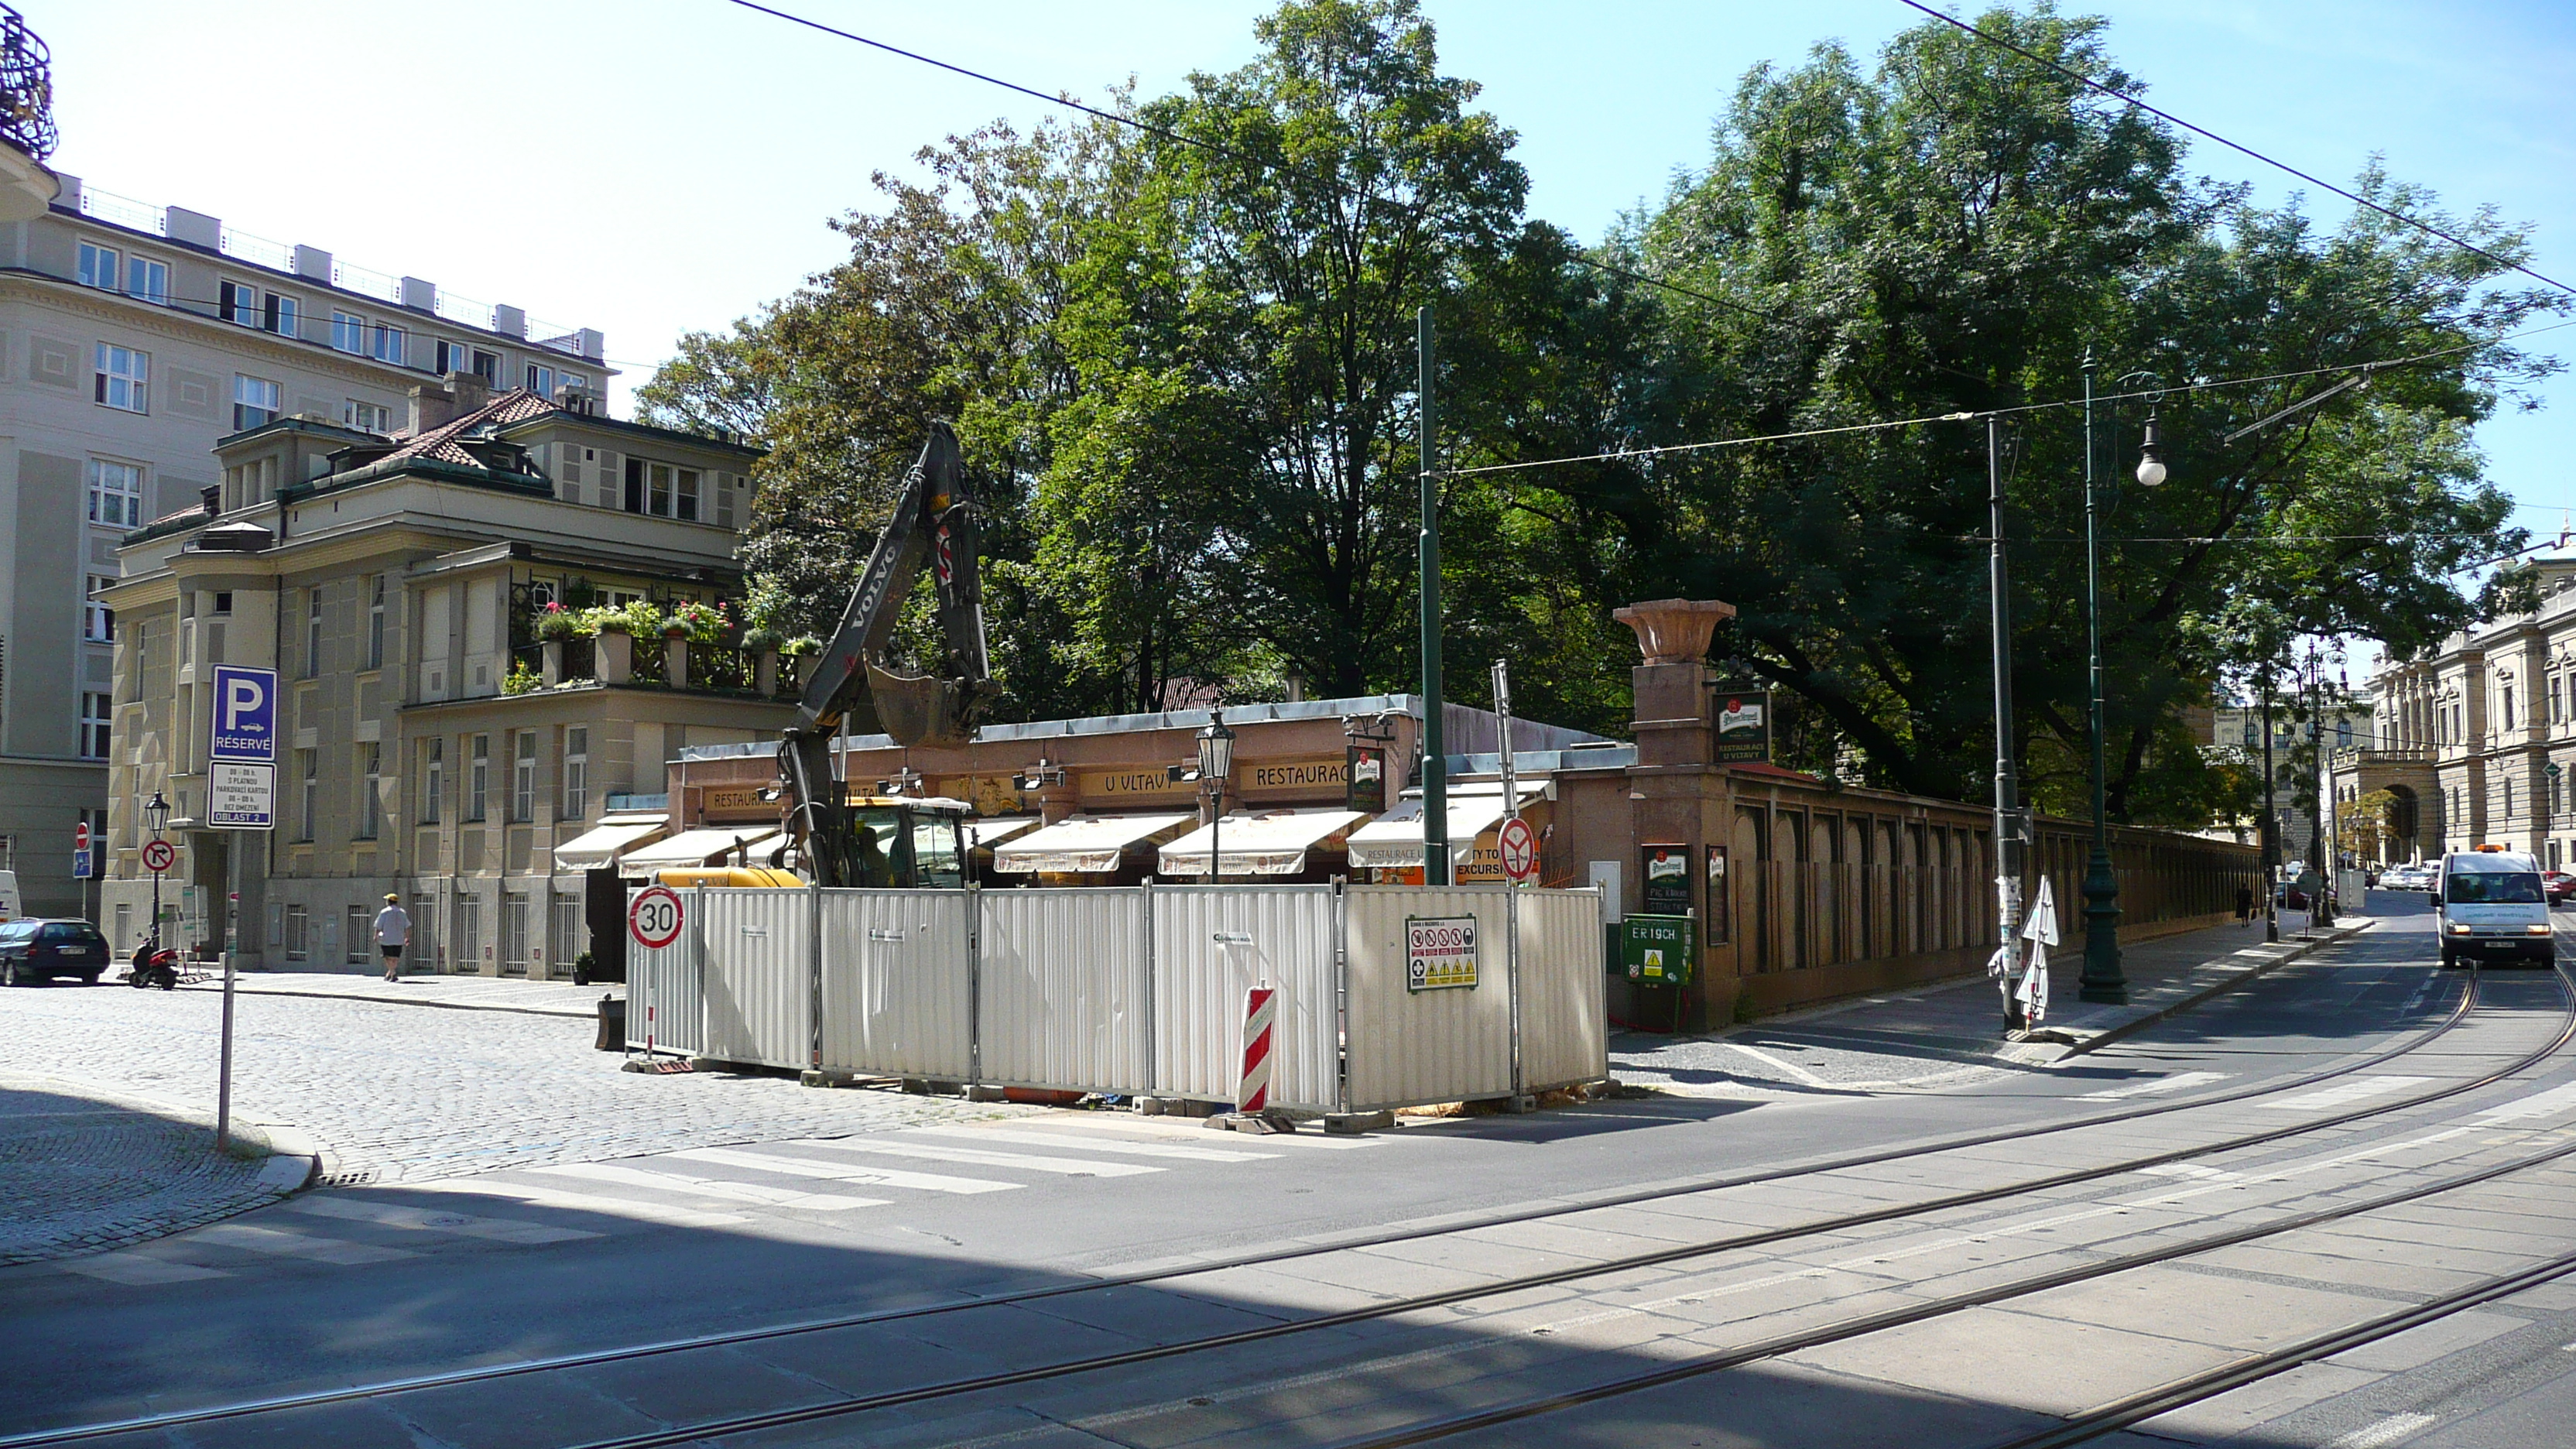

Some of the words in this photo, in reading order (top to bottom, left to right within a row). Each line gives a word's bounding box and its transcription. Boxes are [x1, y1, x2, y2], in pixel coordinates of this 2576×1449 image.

[851, 545, 897, 630] VOLVO
[226, 678, 264, 730] P
[216, 735, 271, 751] RÉSERVÉ
[1718, 743, 1765, 752] RESTAURACE
[1257, 764, 1348, 786] RESTAURAC
[1105, 776, 1115, 792] U
[714, 792, 777, 808] RESTAUR
[215, 813, 251, 822] OBLAST
[254, 814, 260, 822] 2
[1368, 848, 1416, 859] RESTAURACE
[1472, 849, 1485, 859] TY
[1485, 849, 1500, 859] TO
[1458, 864, 1503, 875] EXCURSI
[688, 876, 728, 887] VLVO
[639, 903, 674, 933] 30
